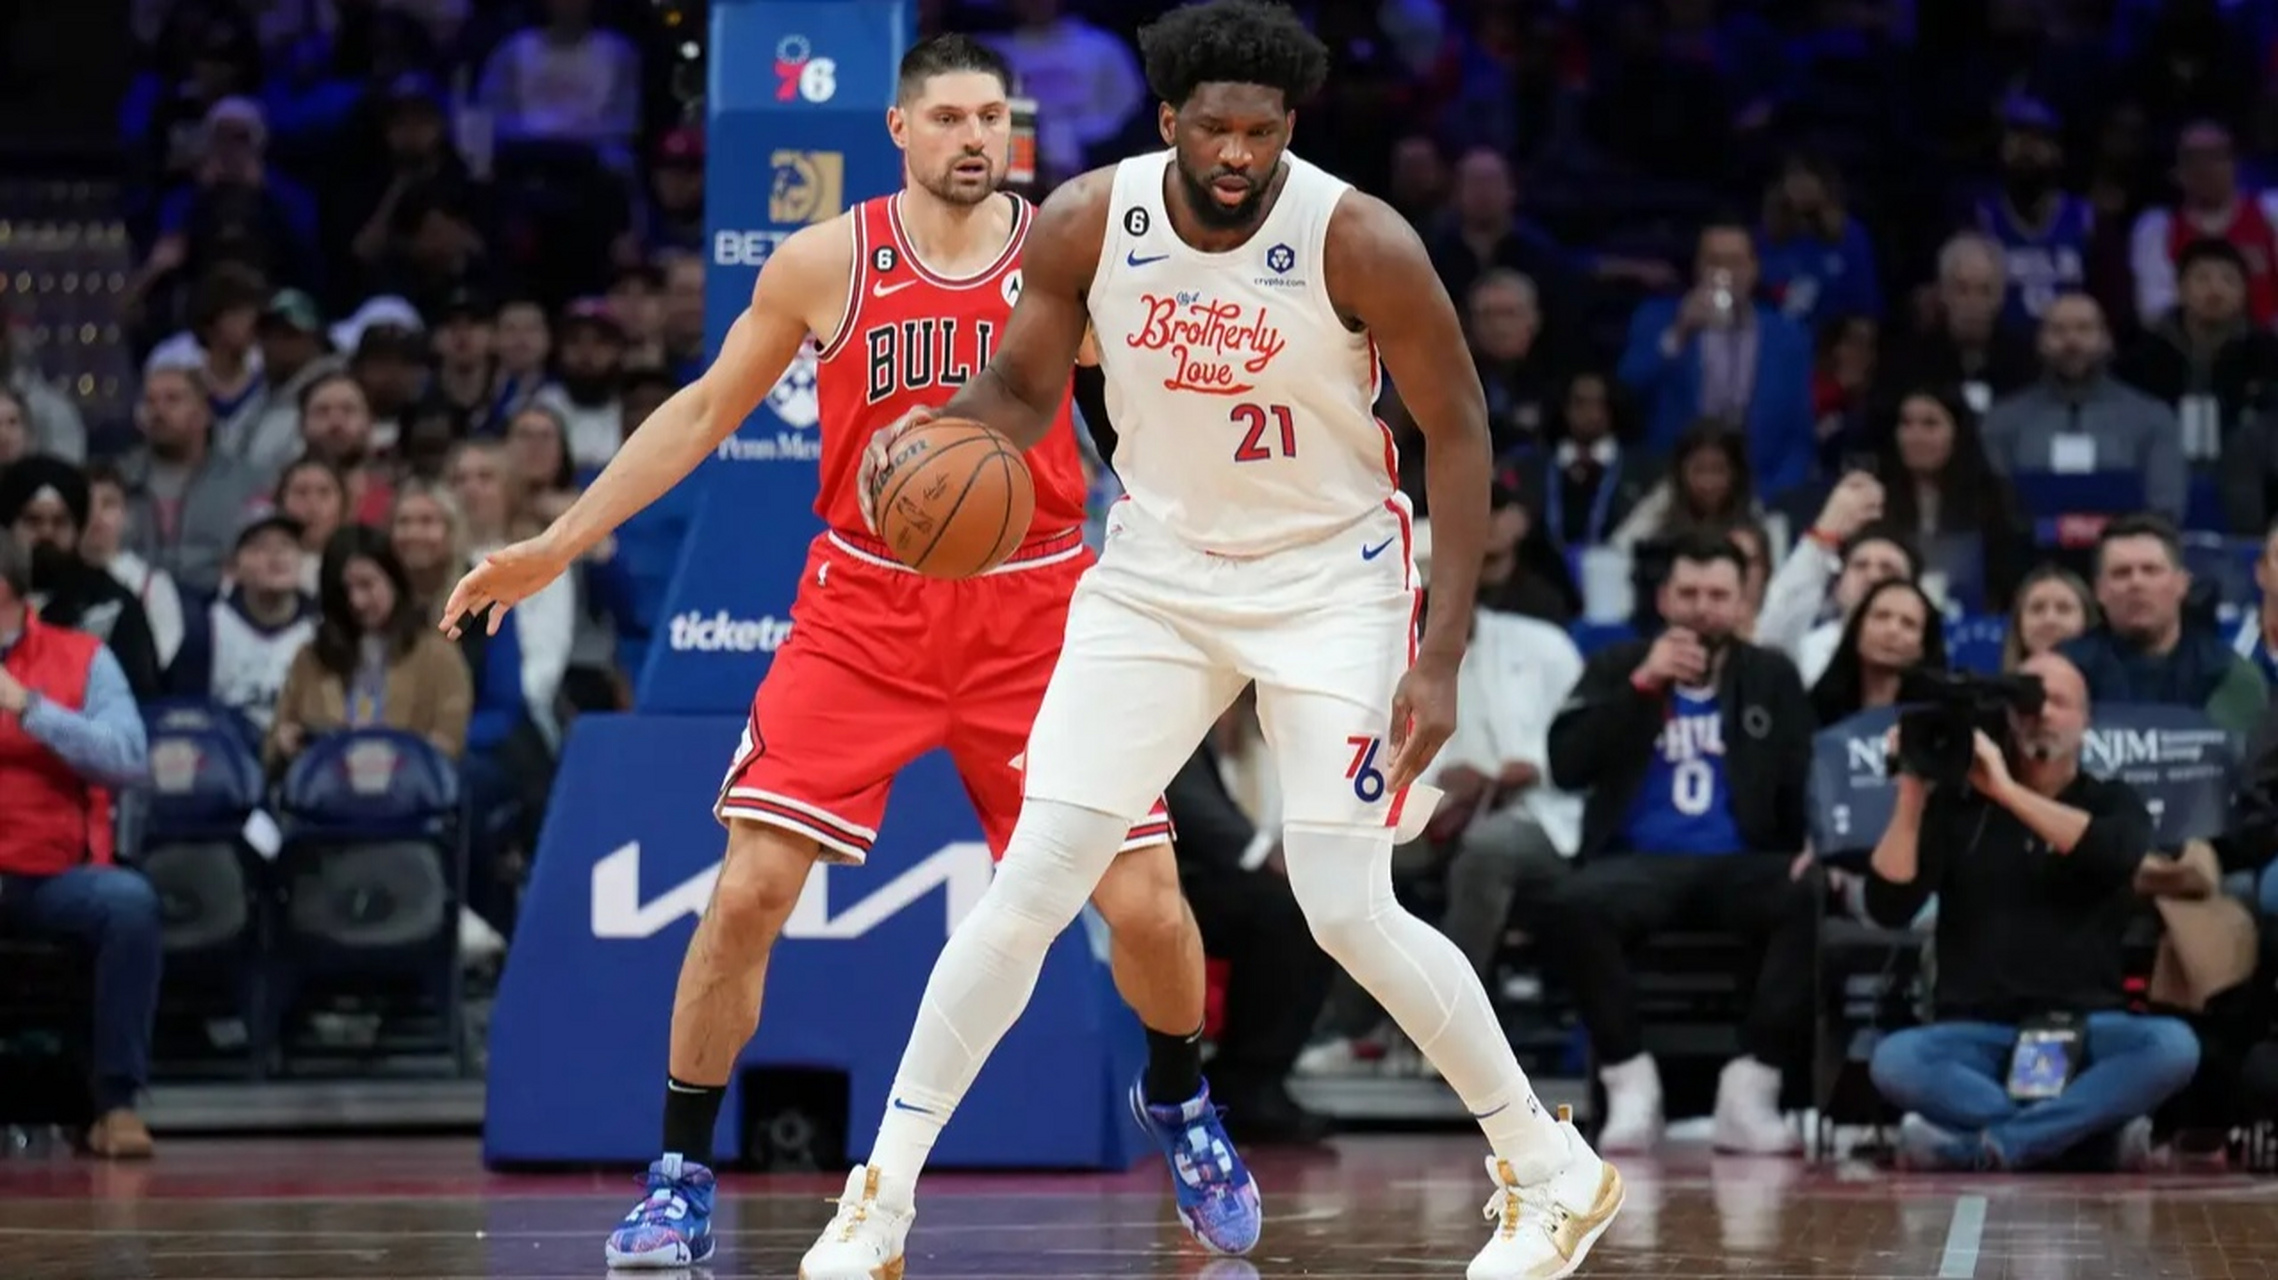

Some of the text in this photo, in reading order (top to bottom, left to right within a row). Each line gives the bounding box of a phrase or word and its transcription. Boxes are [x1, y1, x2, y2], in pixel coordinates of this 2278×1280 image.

[774, 58, 837, 103] 76
[1130, 210, 1145, 234] 6
[877, 248, 893, 271] 6
[1254, 277, 1306, 289] crypto.com
[1126, 293, 1286, 373] Brotherly
[1163, 345, 1255, 396] Love
[1230, 403, 1297, 463] 21
[1345, 735, 1385, 803] 76
[2081, 728, 2158, 773] NJM
[1671, 757, 1714, 816] 0
